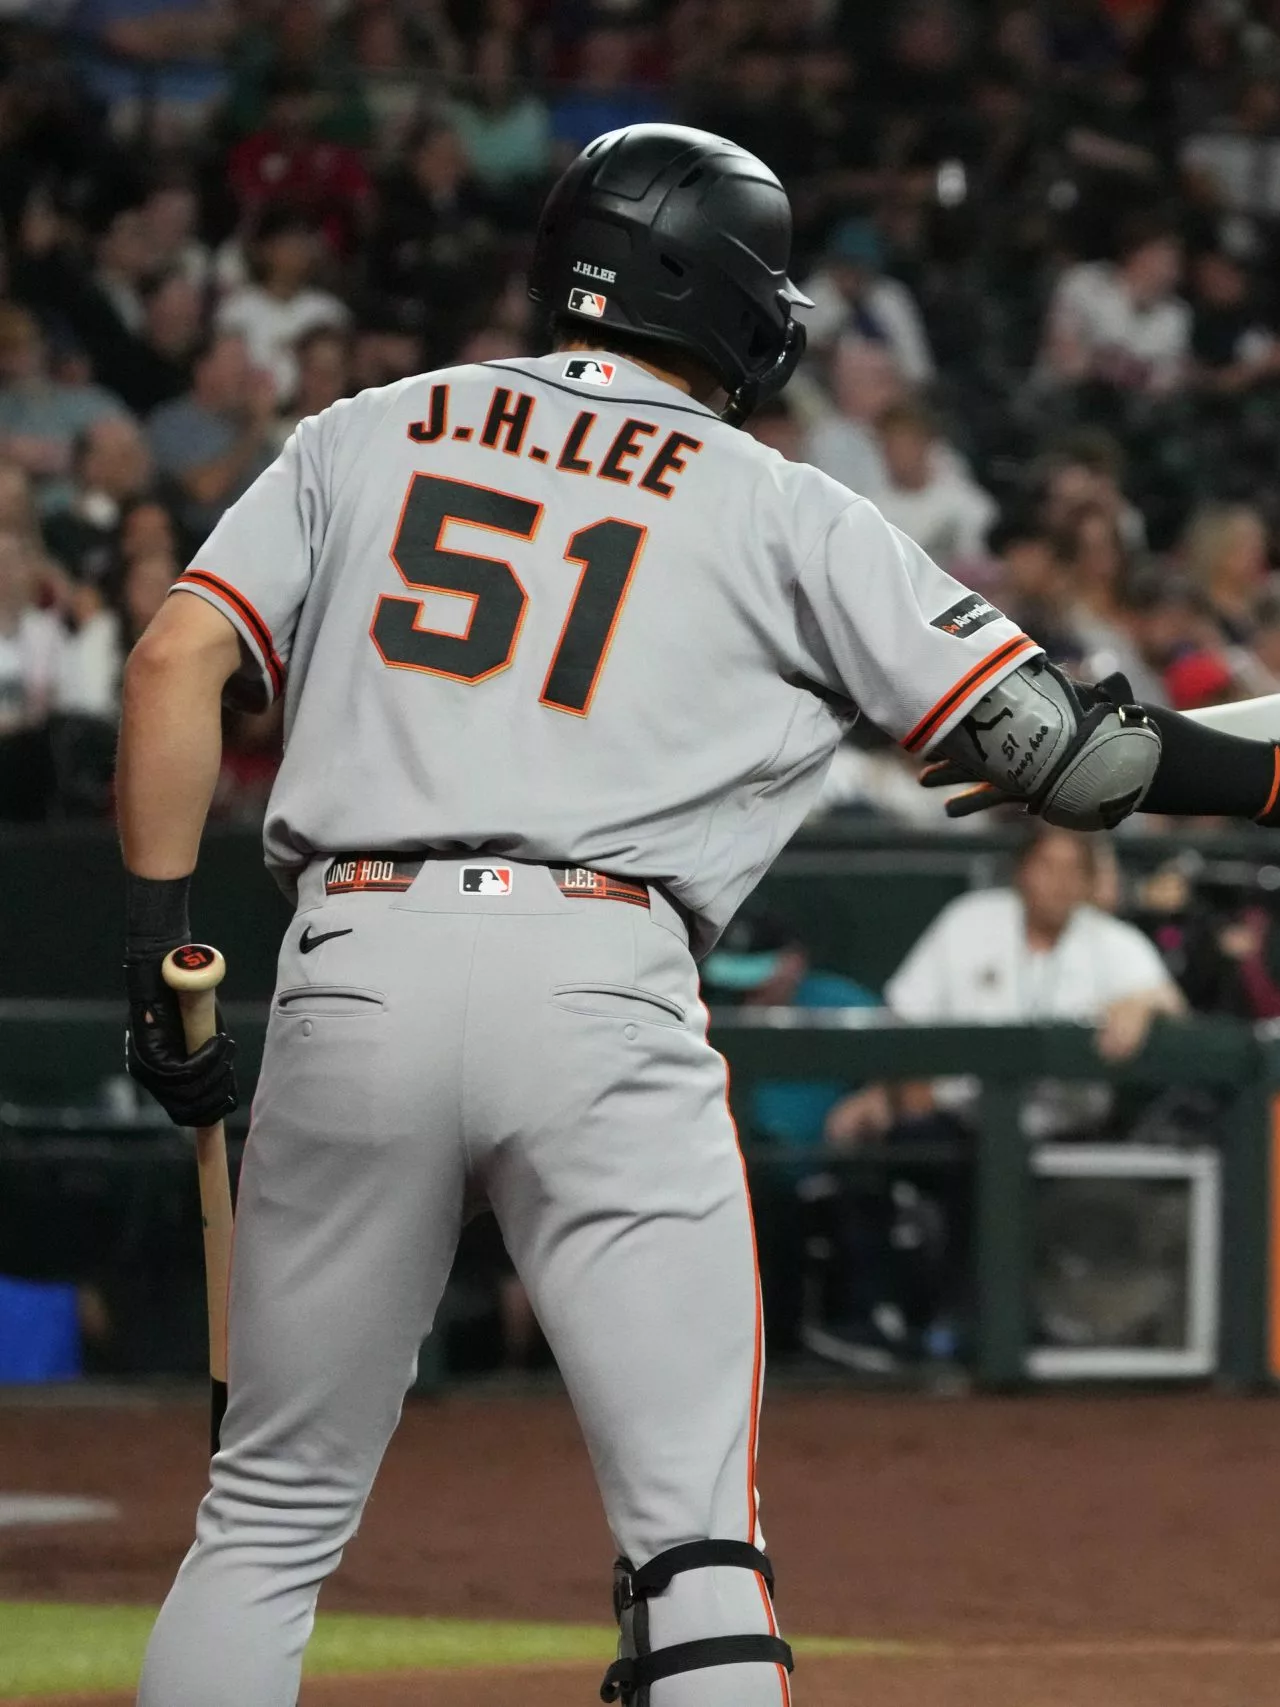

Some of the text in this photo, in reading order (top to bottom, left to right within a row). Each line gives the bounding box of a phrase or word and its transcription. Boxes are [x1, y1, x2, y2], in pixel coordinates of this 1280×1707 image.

[572, 260, 617, 284] J.H.LEE
[407, 383, 704, 500] J.H.LEE
[368, 470, 649, 720] 51
[1001, 733, 1020, 761] 51
[327, 860, 597, 888] UNG HOO LEE
